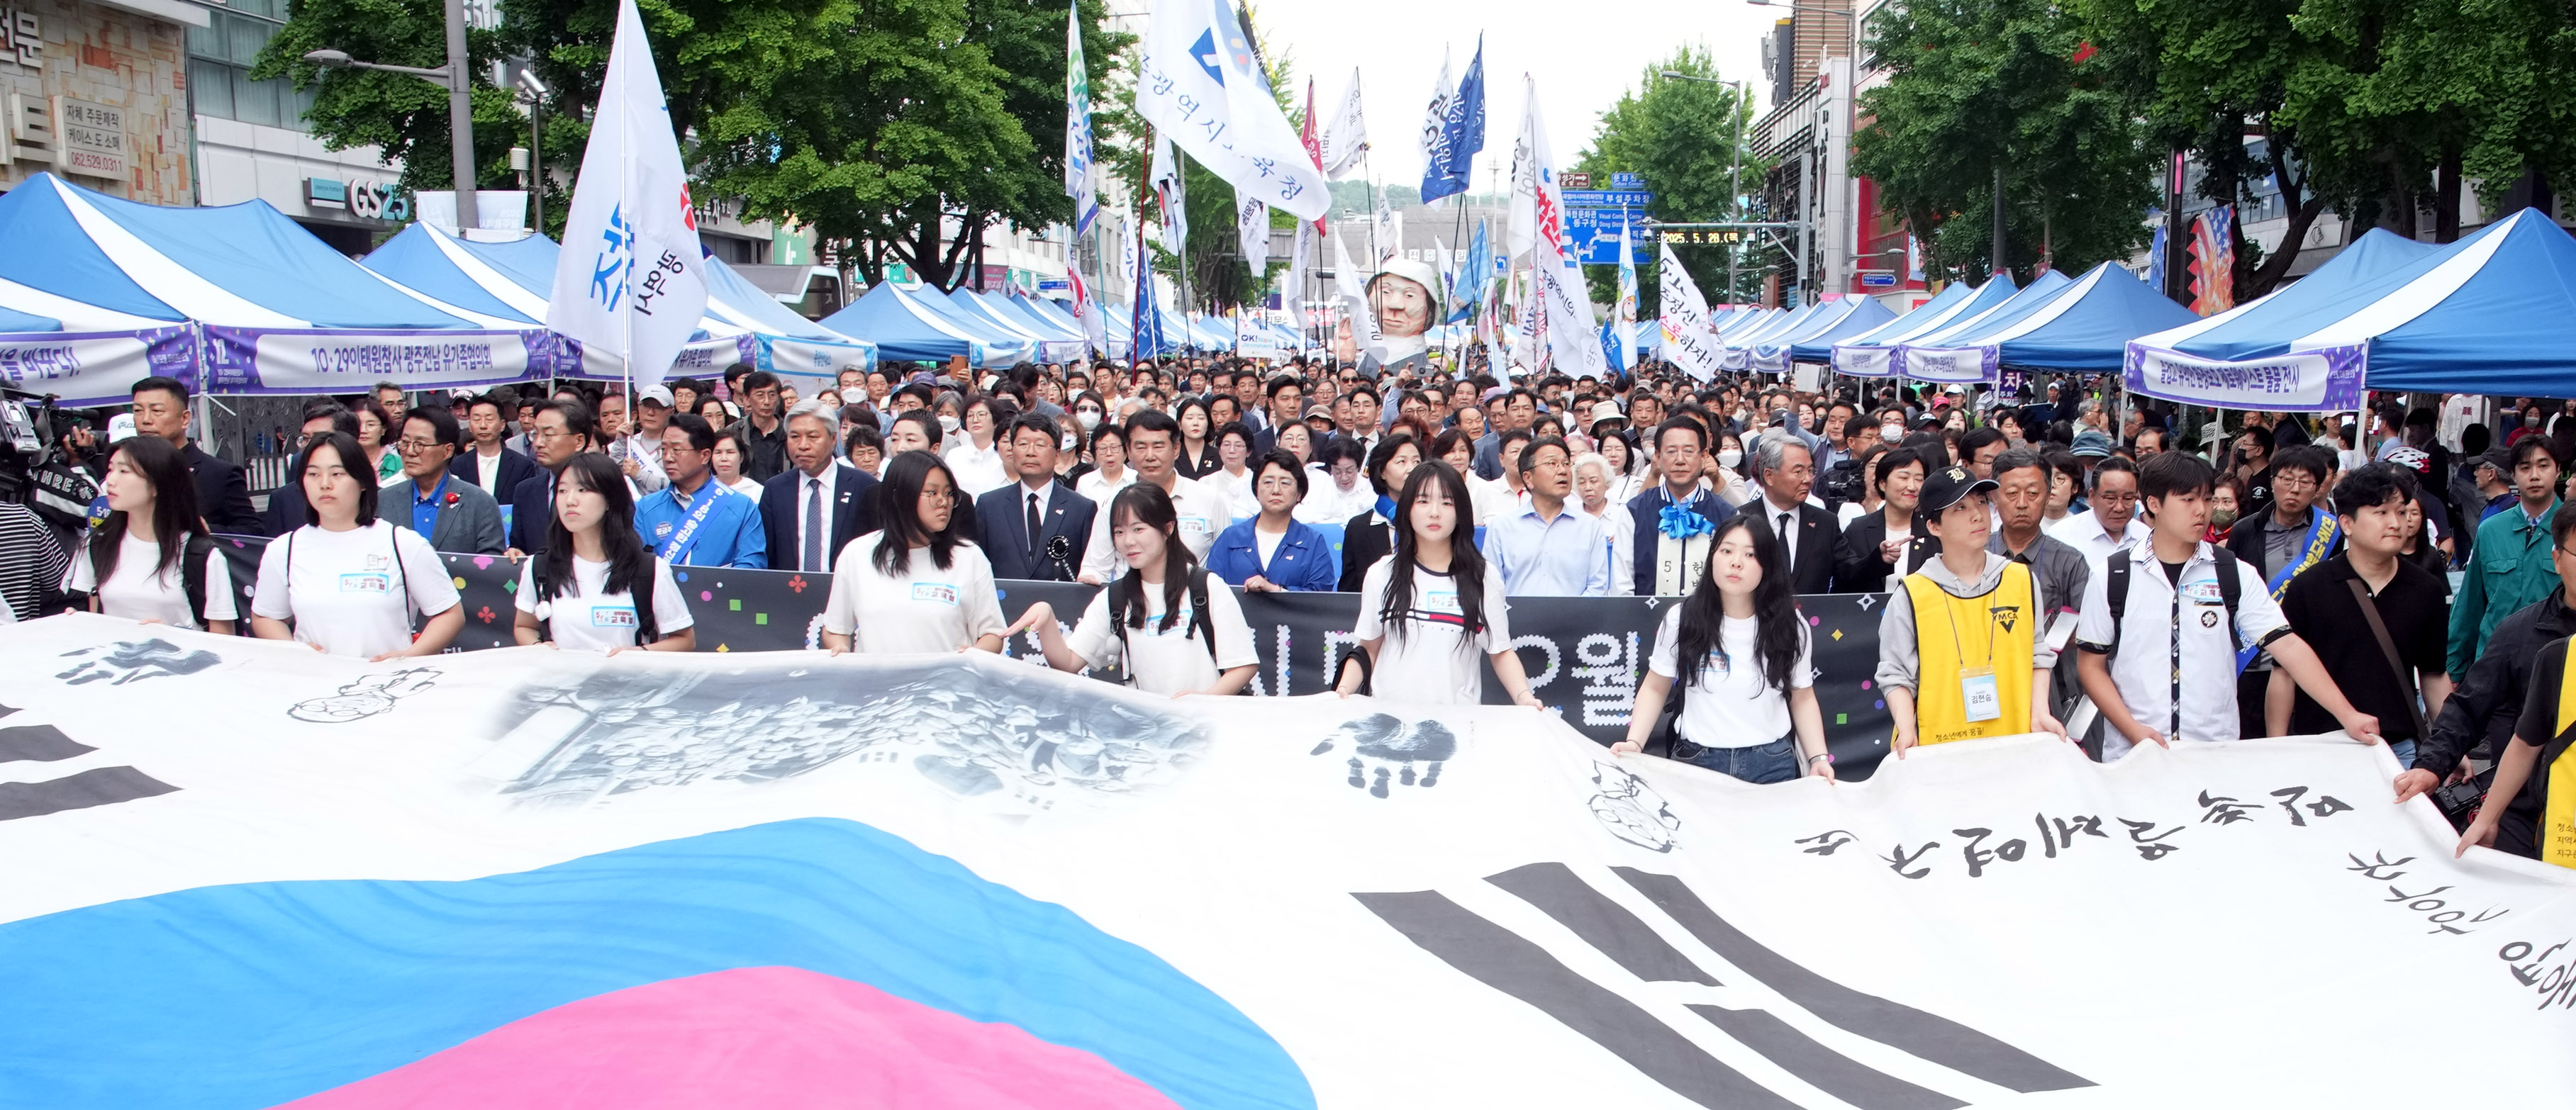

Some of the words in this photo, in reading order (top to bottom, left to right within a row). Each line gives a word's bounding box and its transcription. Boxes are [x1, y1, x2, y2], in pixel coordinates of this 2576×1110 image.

[67, 105, 83, 122] 자체
[87, 108, 119, 128] 주문제작
[68, 128, 92, 145] 케이스
[95, 135, 103, 147] 도
[105, 137, 121, 151] 소매
[72, 151, 123, 172] 062.529.0311
[351, 179, 408, 220] GS25
[1606, 194, 1651, 203] 부설주차장
[1573, 219, 1597, 228] 동구청
[1693, 232, 1704, 243] 5.
[1241, 334, 1258, 342] OK!
[0, 348, 23, 380] 을
[311, 345, 402, 374] 10·29이태원참사
[404, 344, 441, 374] 광주전남
[442, 343, 494, 369] 유가족협의회
[2263, 366, 2281, 393] 물품
[2282, 364, 2300, 393] 전시
[1992, 612, 2019, 622] YMCA
[1935, 731, 1968, 742] 청소년에게
[1968, 727, 1985, 736] 꿈을!
[2557, 823, 2576, 833] 청소
